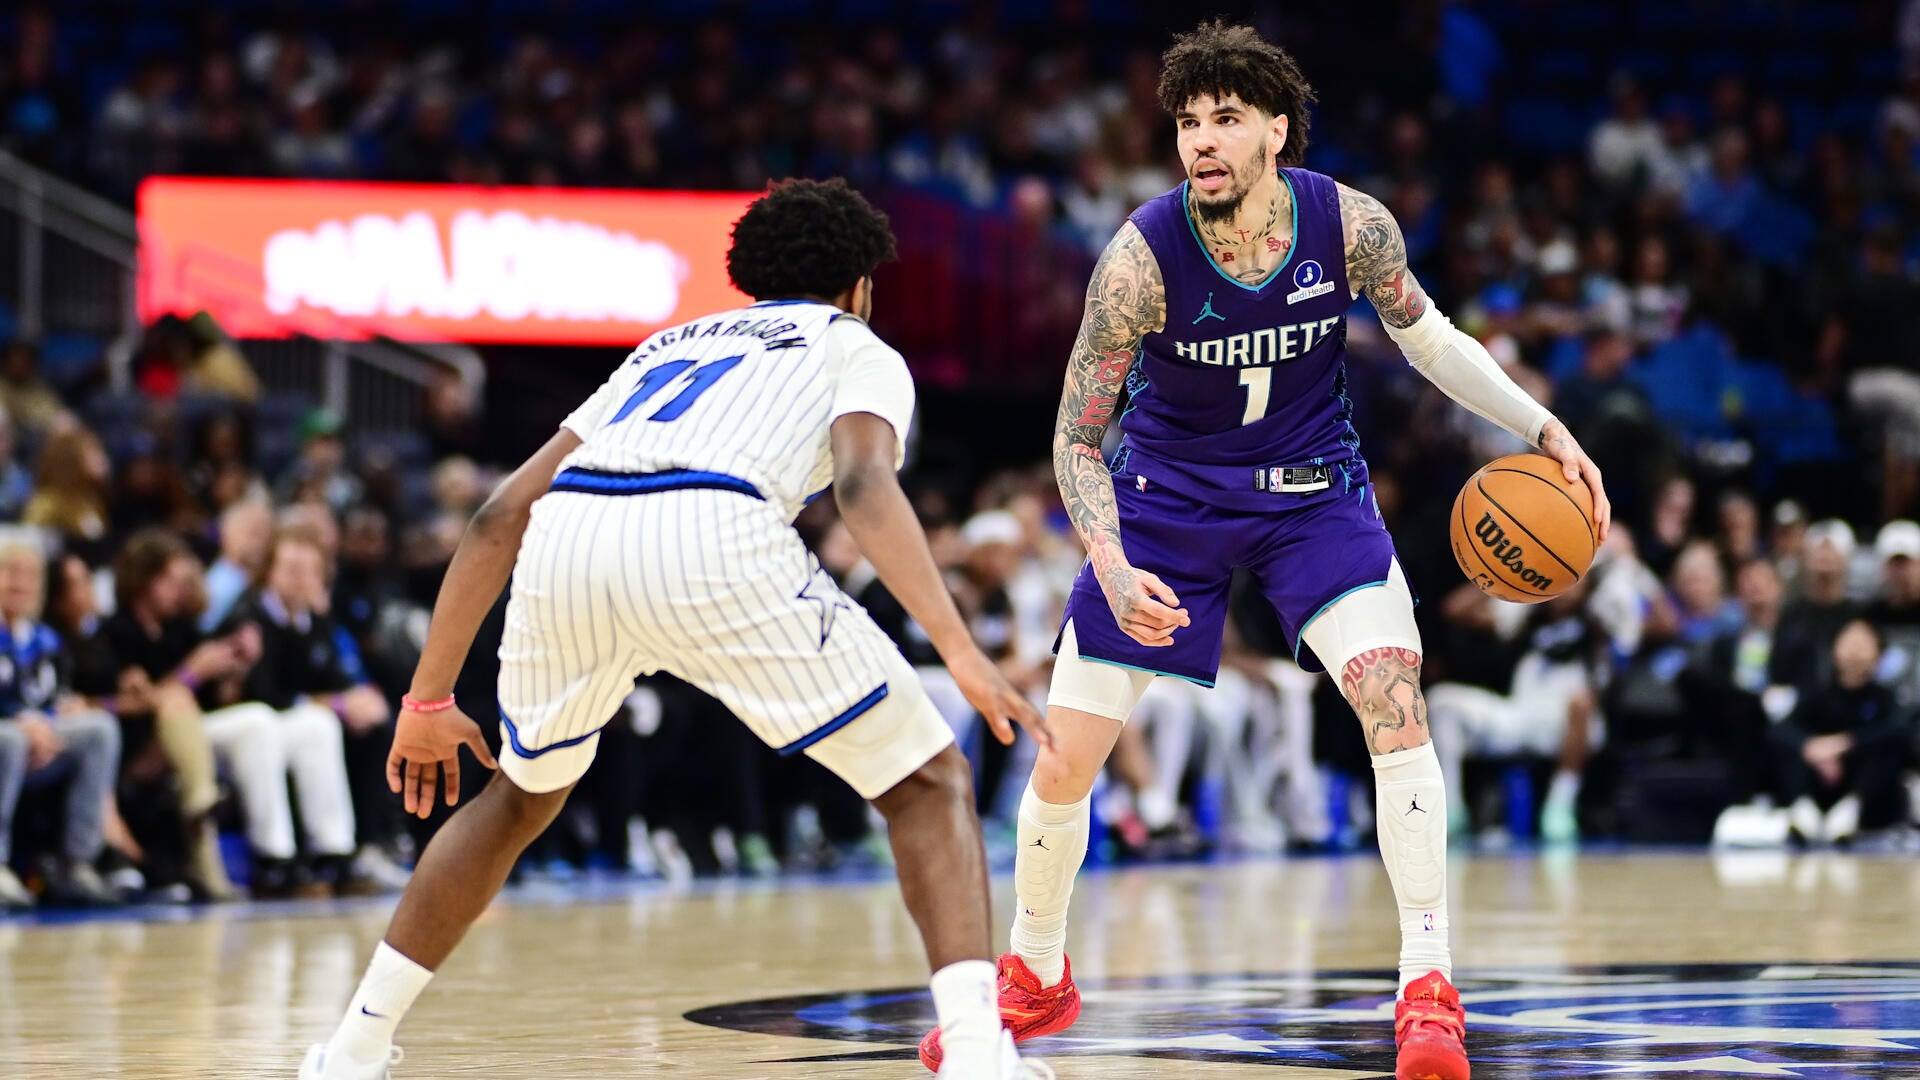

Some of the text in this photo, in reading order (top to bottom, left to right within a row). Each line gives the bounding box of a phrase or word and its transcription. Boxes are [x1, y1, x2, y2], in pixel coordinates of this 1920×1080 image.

[1288, 283, 1335, 303] Judi Health
[1173, 315, 1341, 367] HORNETS
[609, 353, 747, 425] 11
[1238, 366, 1273, 427] 1
[1475, 511, 1553, 591] Wilson
